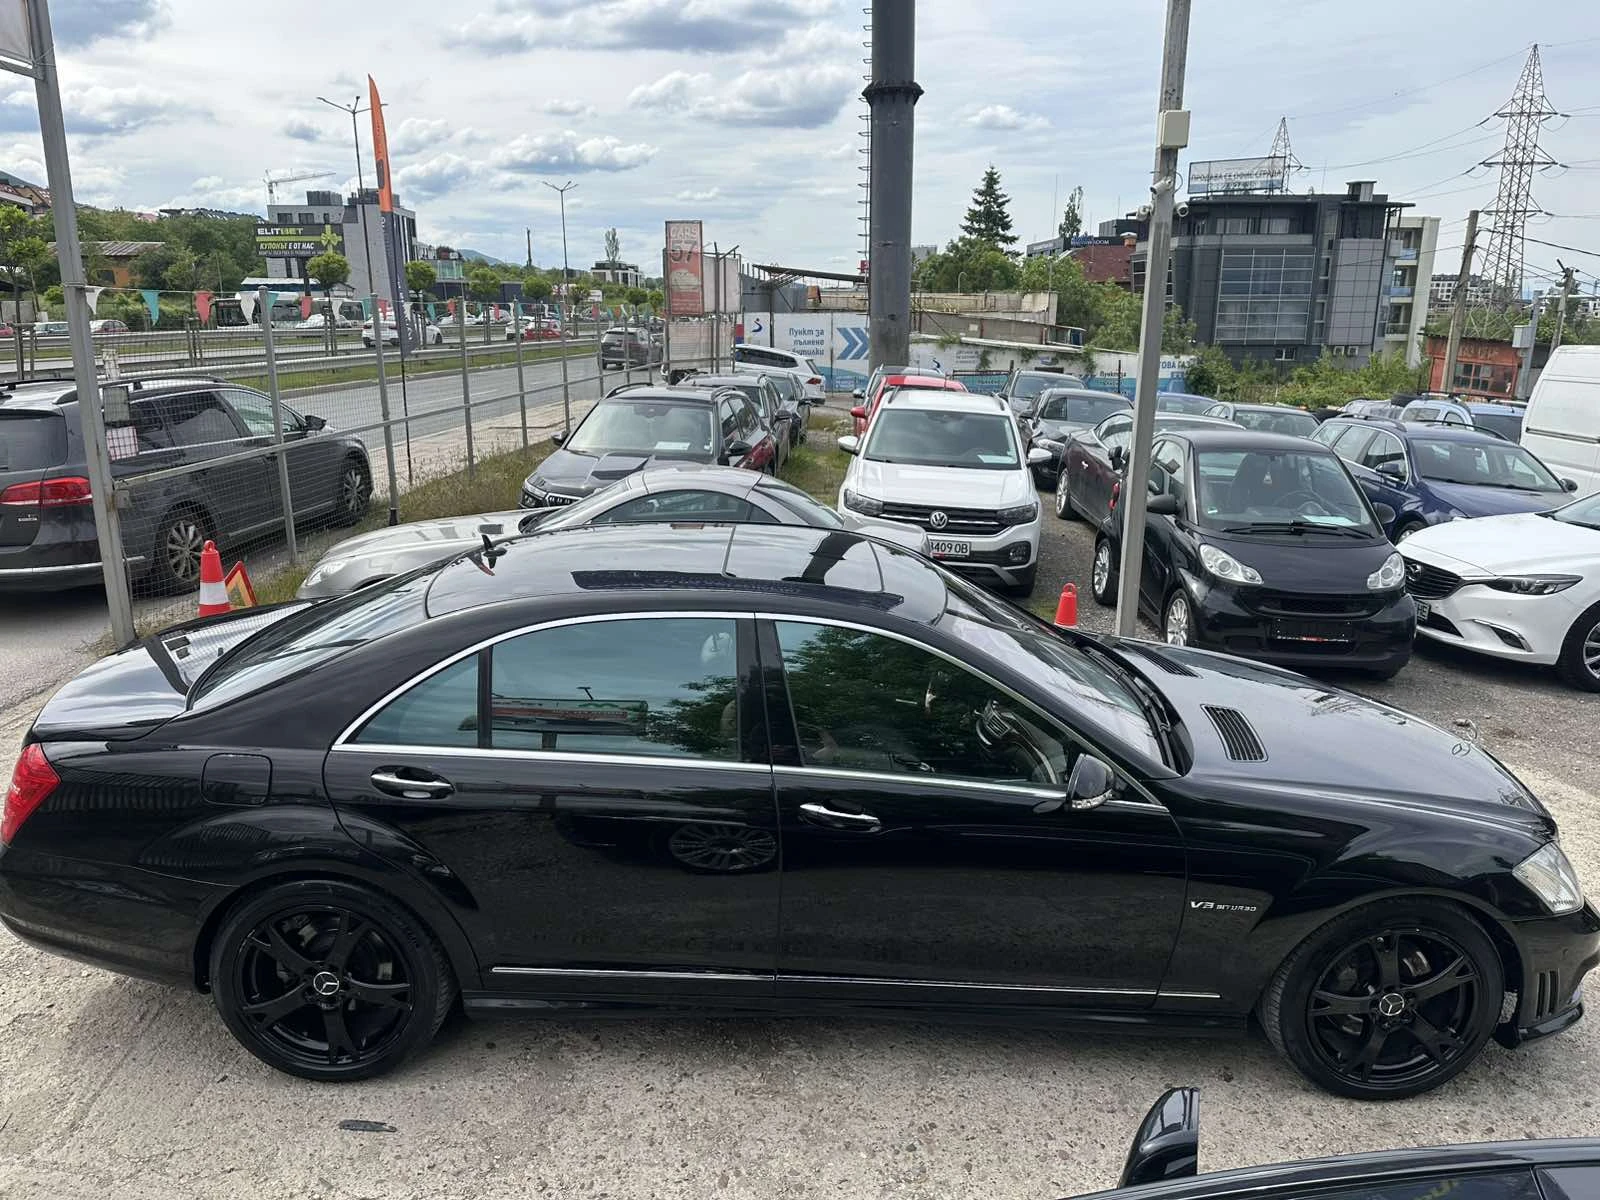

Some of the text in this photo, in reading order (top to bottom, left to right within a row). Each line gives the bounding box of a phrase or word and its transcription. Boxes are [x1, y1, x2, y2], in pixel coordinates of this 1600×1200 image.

[671, 240, 698, 262] 57
[789, 327, 825, 338] Пункт за
[1190, 901, 1257, 912] V8 BITURBO
